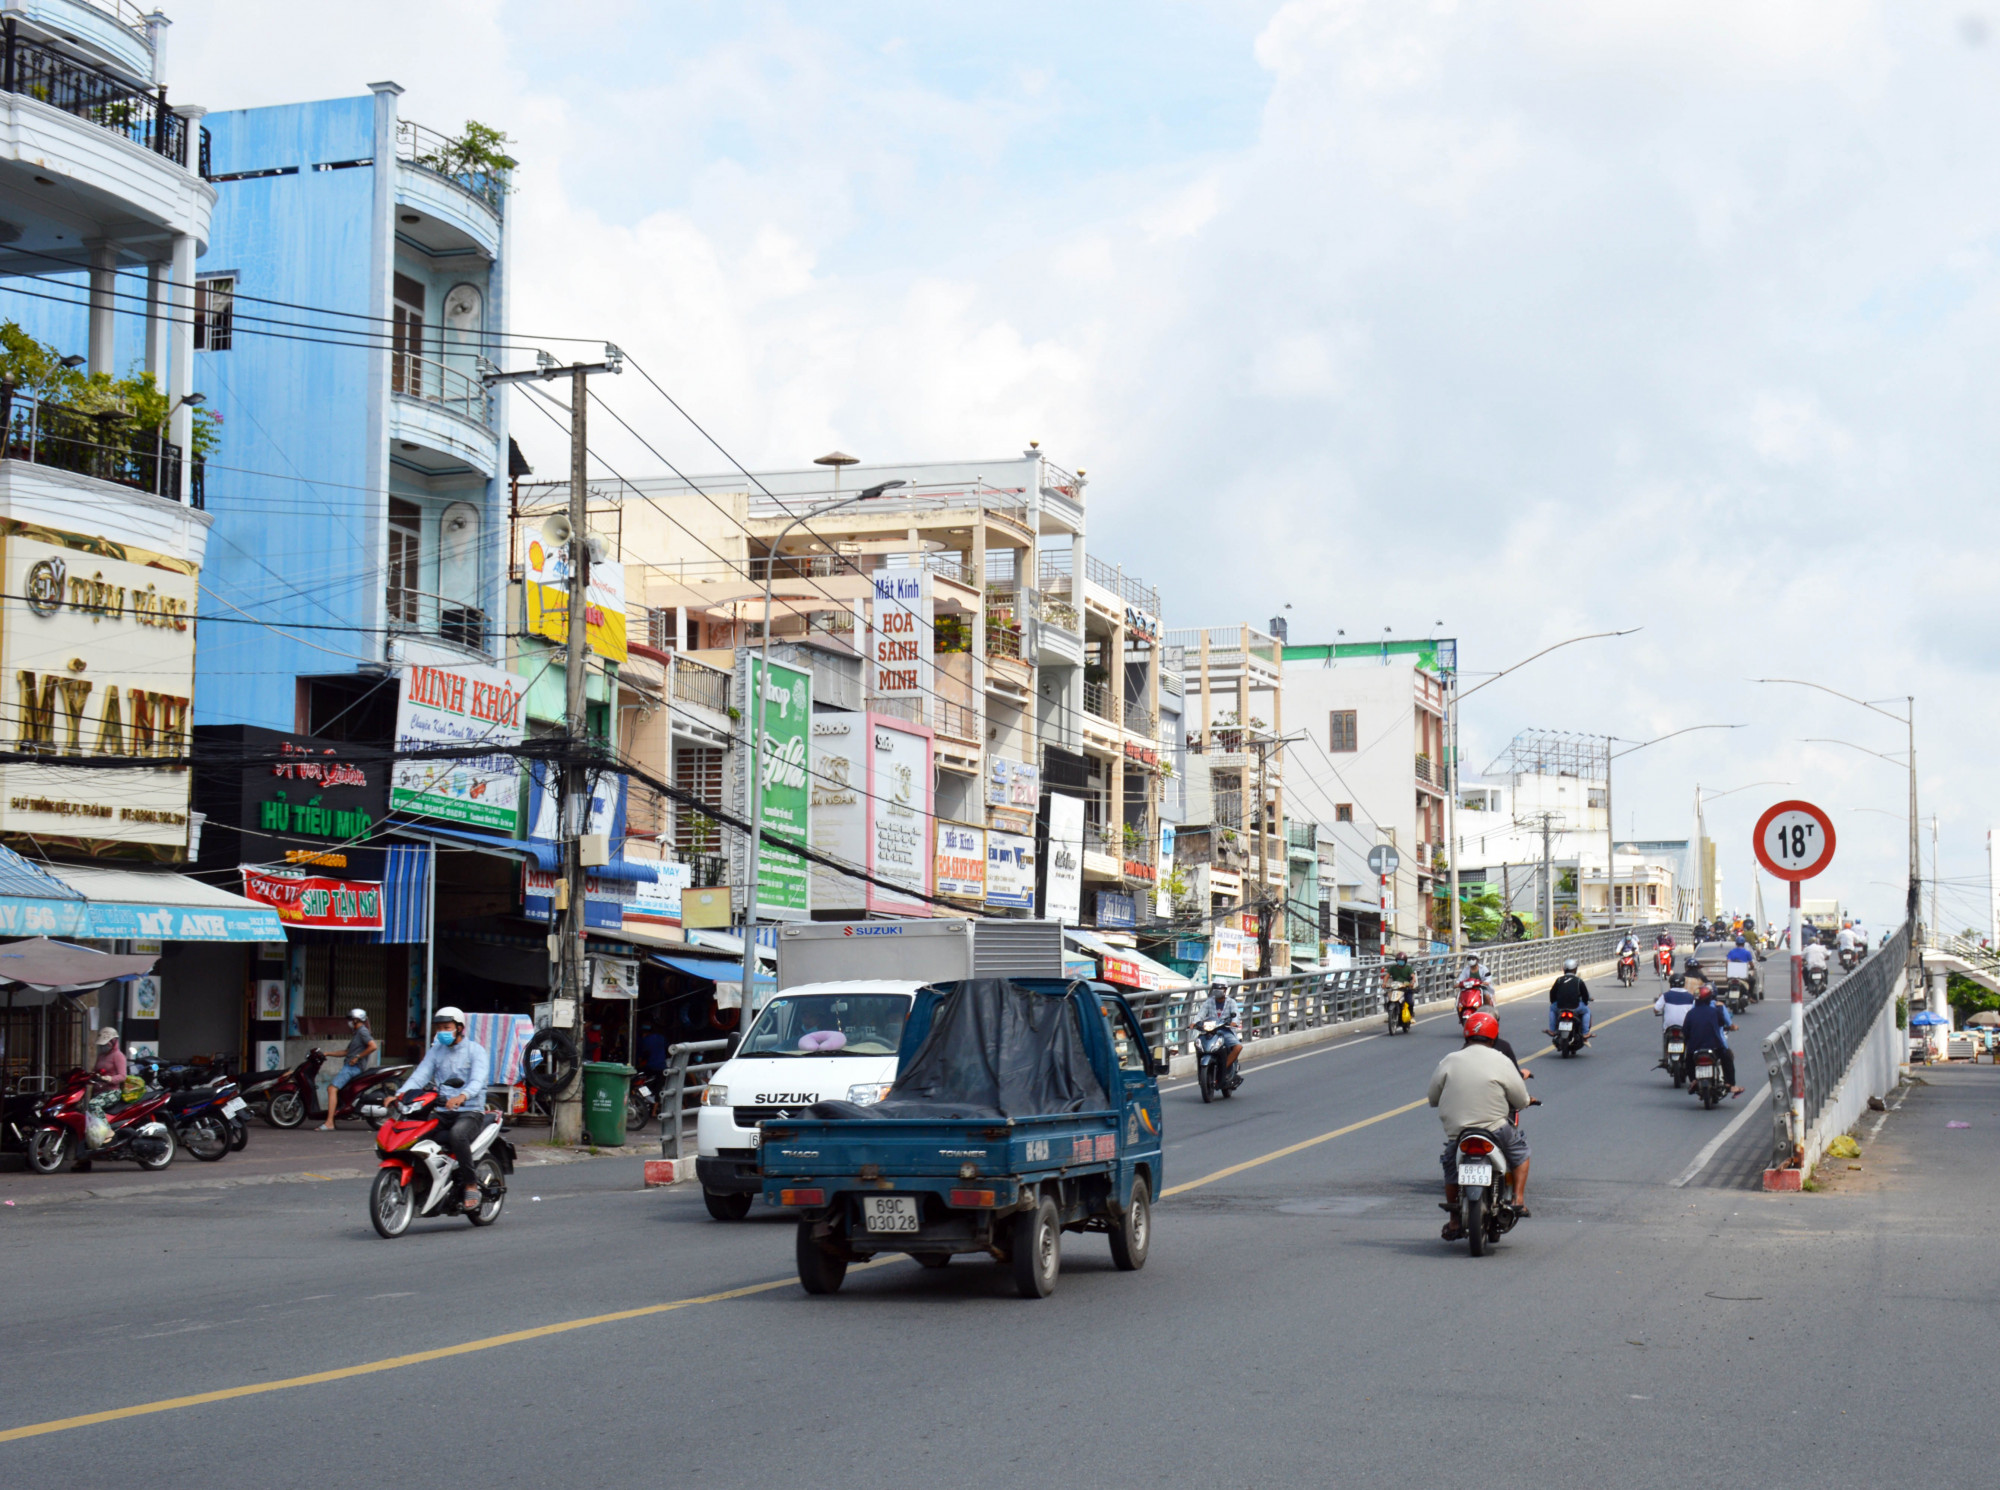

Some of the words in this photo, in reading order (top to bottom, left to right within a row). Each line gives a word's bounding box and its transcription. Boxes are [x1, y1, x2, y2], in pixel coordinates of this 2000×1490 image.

[875, 576, 895, 600] Mắt
[897, 578, 920, 599] Kính
[68, 571, 126, 624] TIỆM
[131, 582, 188, 632] VÀNG
[882, 607, 914, 634] HÒA
[878, 640, 919, 661] SANH
[879, 669, 918, 691] MINH
[408, 663, 467, 713] MINH
[470, 679, 522, 728] KHÔI
[92, 685, 190, 772] ANH
[300, 888, 331, 917] SHIP
[331, 883, 358, 923] TẬN
[25, 906, 56, 930] 56
[179, 914, 229, 937] ANH
[856, 926, 903, 936] SUZUKI
[755, 1093, 820, 1104] SUZUKI
[781, 1150, 820, 1158] THACO
[938, 1149, 988, 1158] TOWNER
[1464, 1165, 1486, 1175] 69-C1
[876, 1199, 904, 1214] 69C
